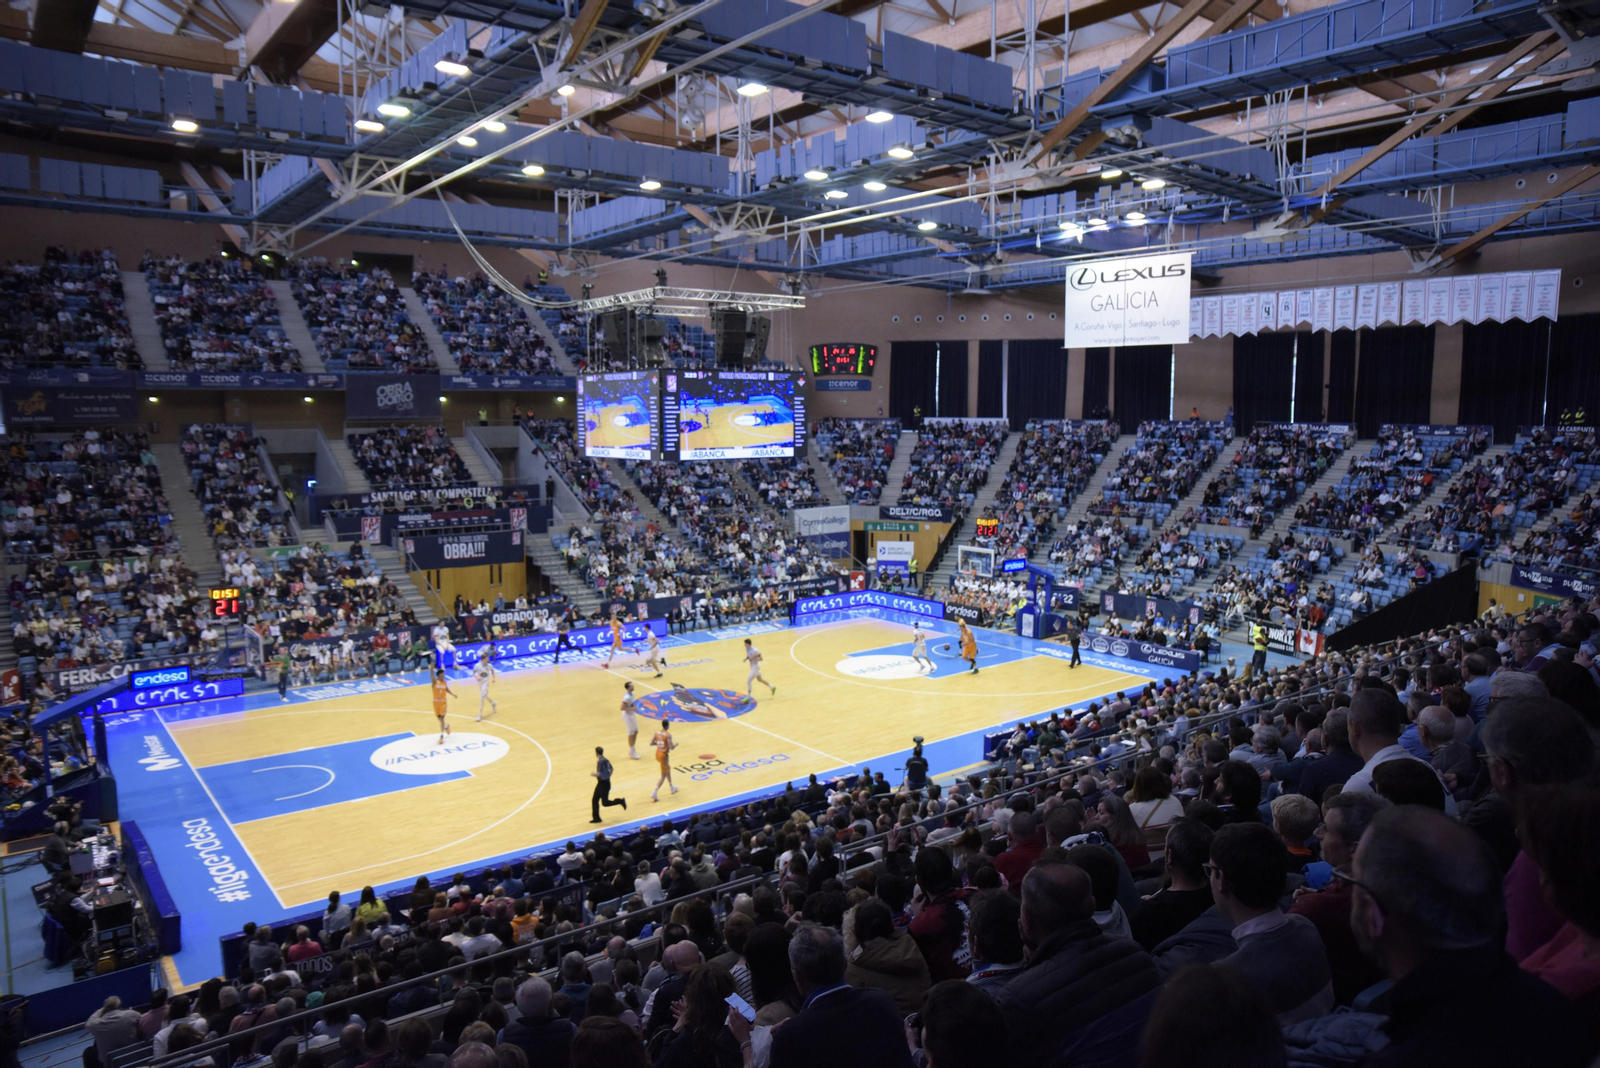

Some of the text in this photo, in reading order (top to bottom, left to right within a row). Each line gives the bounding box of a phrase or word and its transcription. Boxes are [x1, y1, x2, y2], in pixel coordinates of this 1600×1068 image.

[1100, 263, 1186, 283] LEXUS
[1090, 290, 1159, 312] GALICIA
[1264, 306, 1271, 316] 4
[1074, 323, 1080, 331] A
[1081, 321, 1104, 331] Coruña
[1108, 321, 1122, 331] Vigo
[1129, 319, 1157, 330] Santiago
[1163, 317, 1181, 328] Lugo
[376, 381, 413, 397] OBRA
[693, 450, 726, 458] ABANCA
[755, 449, 786, 457] ABANCA
[444, 541, 486, 560] OBRA!!!
[1004, 561, 1025, 571] endesa
[1063, 593, 1074, 604] 22
[215, 599, 239, 616] 21
[945, 605, 979, 619] endesa
[1153, 647, 1186, 659] LEXUS
[1148, 655, 1175, 667] GALICIA
[134, 670, 188, 687] endesa
[396, 740, 499, 764] ABANCA
[673, 759, 726, 774] liga
[691, 753, 791, 781] endesa
[181, 817, 252, 903] #ligaendesa
